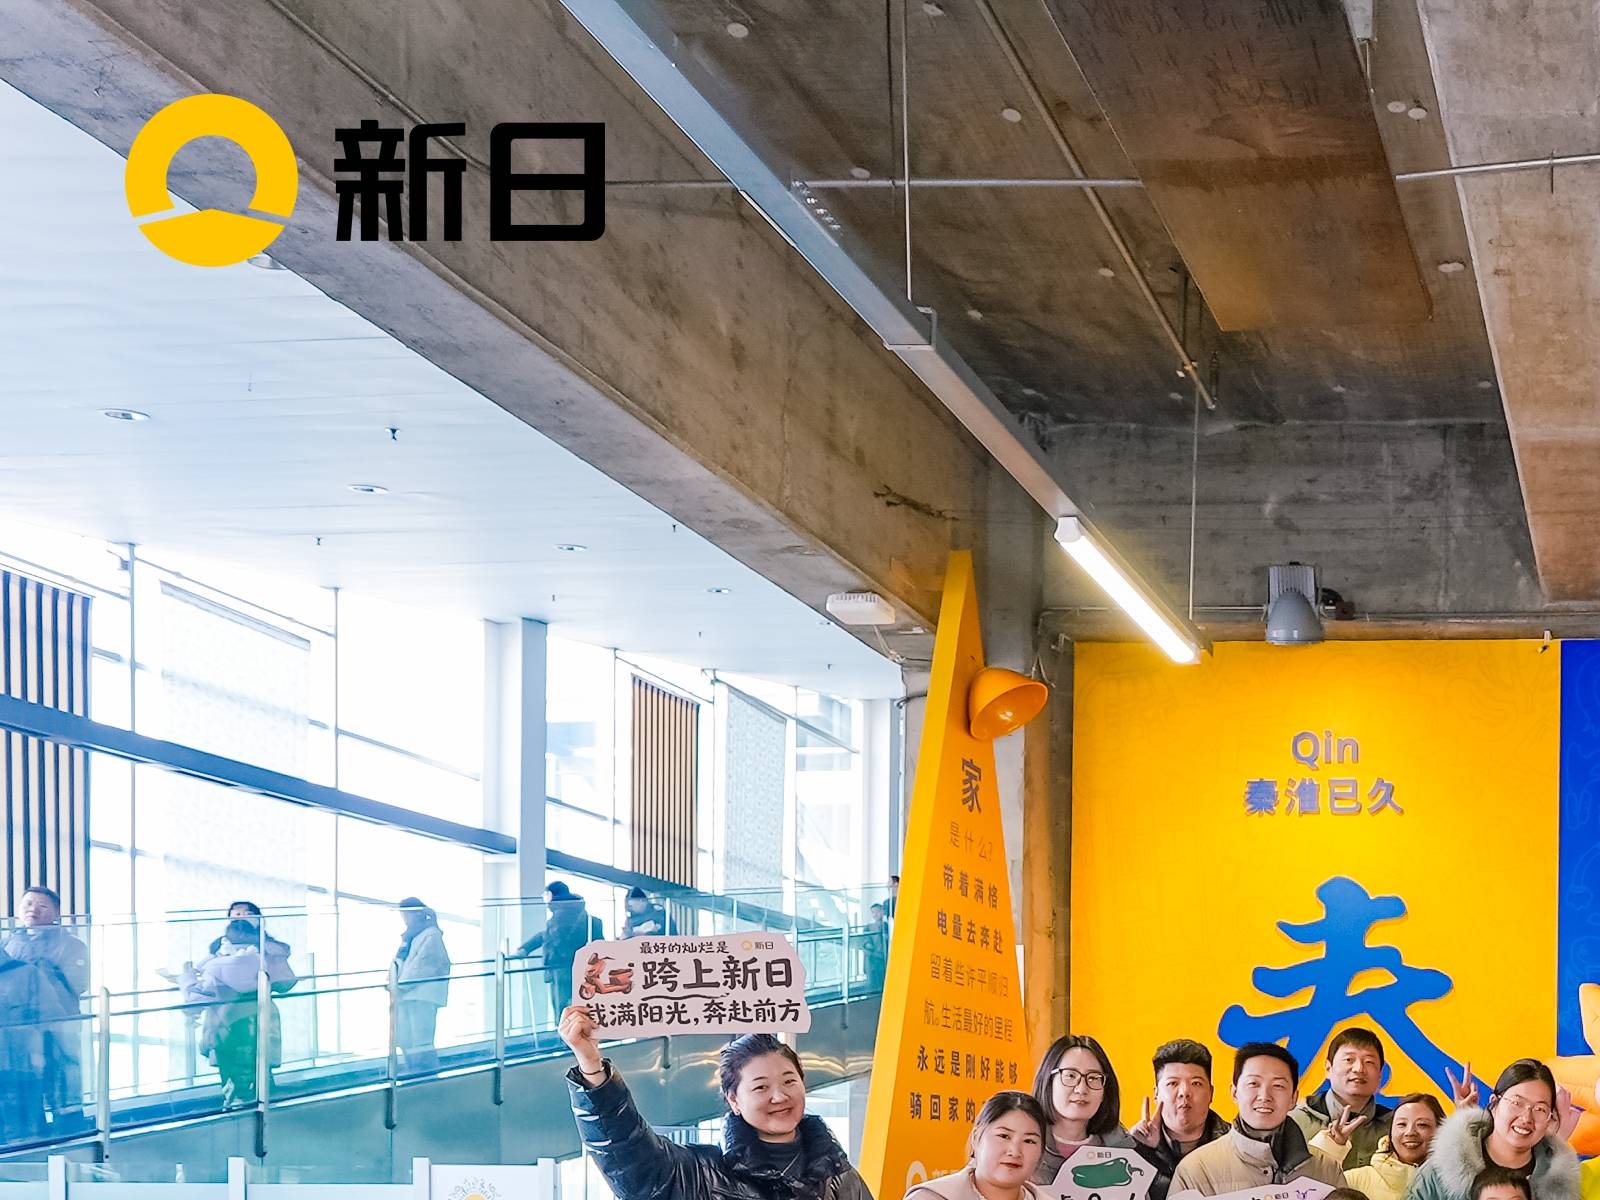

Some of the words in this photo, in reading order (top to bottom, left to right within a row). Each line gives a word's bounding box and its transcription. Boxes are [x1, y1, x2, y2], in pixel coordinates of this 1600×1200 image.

[1291, 730, 1360, 771] Qin
[961, 757, 982, 814] 家
[1243, 778, 1404, 816] 秦淮已久
[640, 941, 730, 954] 最好的灿烂是
[754, 941, 774, 950] 新日
[937, 907, 1004, 955] 电量去奔赴
[642, 955, 793, 993] 跨上新日
[917, 1045, 1018, 1085] 永远是刚好能够
[910, 1092, 986, 1123] 骑回家的
